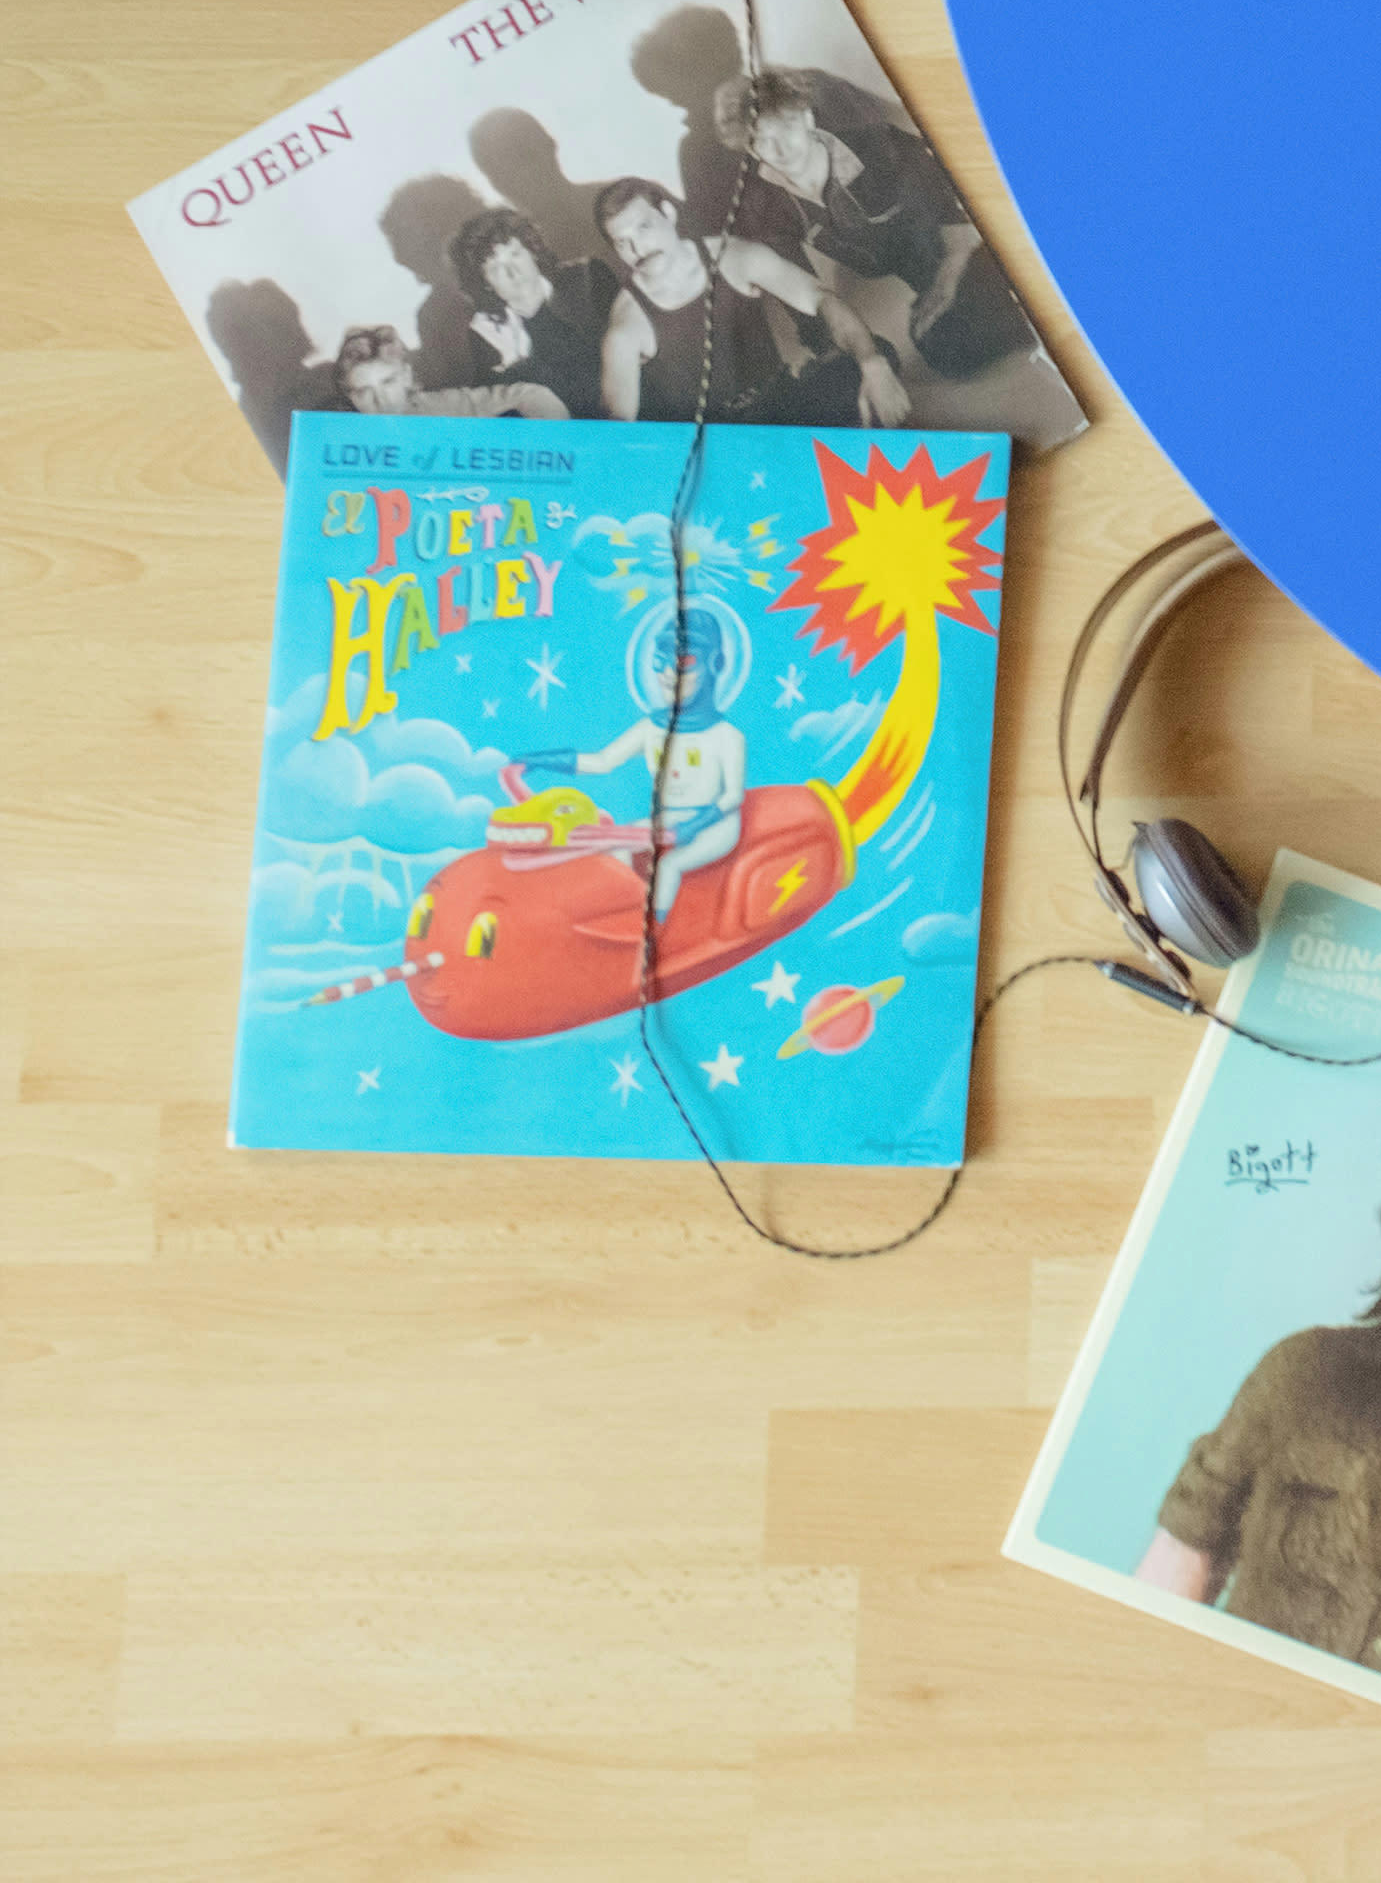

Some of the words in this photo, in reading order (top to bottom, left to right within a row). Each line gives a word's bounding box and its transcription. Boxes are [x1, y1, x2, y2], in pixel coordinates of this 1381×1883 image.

[180, 106, 354, 229] QUEEN
[322, 443, 401, 468] LOVE
[412, 444, 441, 471] of
[451, 446, 576, 474] LESBIAN
[366, 486, 539, 575] POETA
[312, 551, 562, 742] HALLEY
[1227, 1139, 1319, 1192] Bigott
